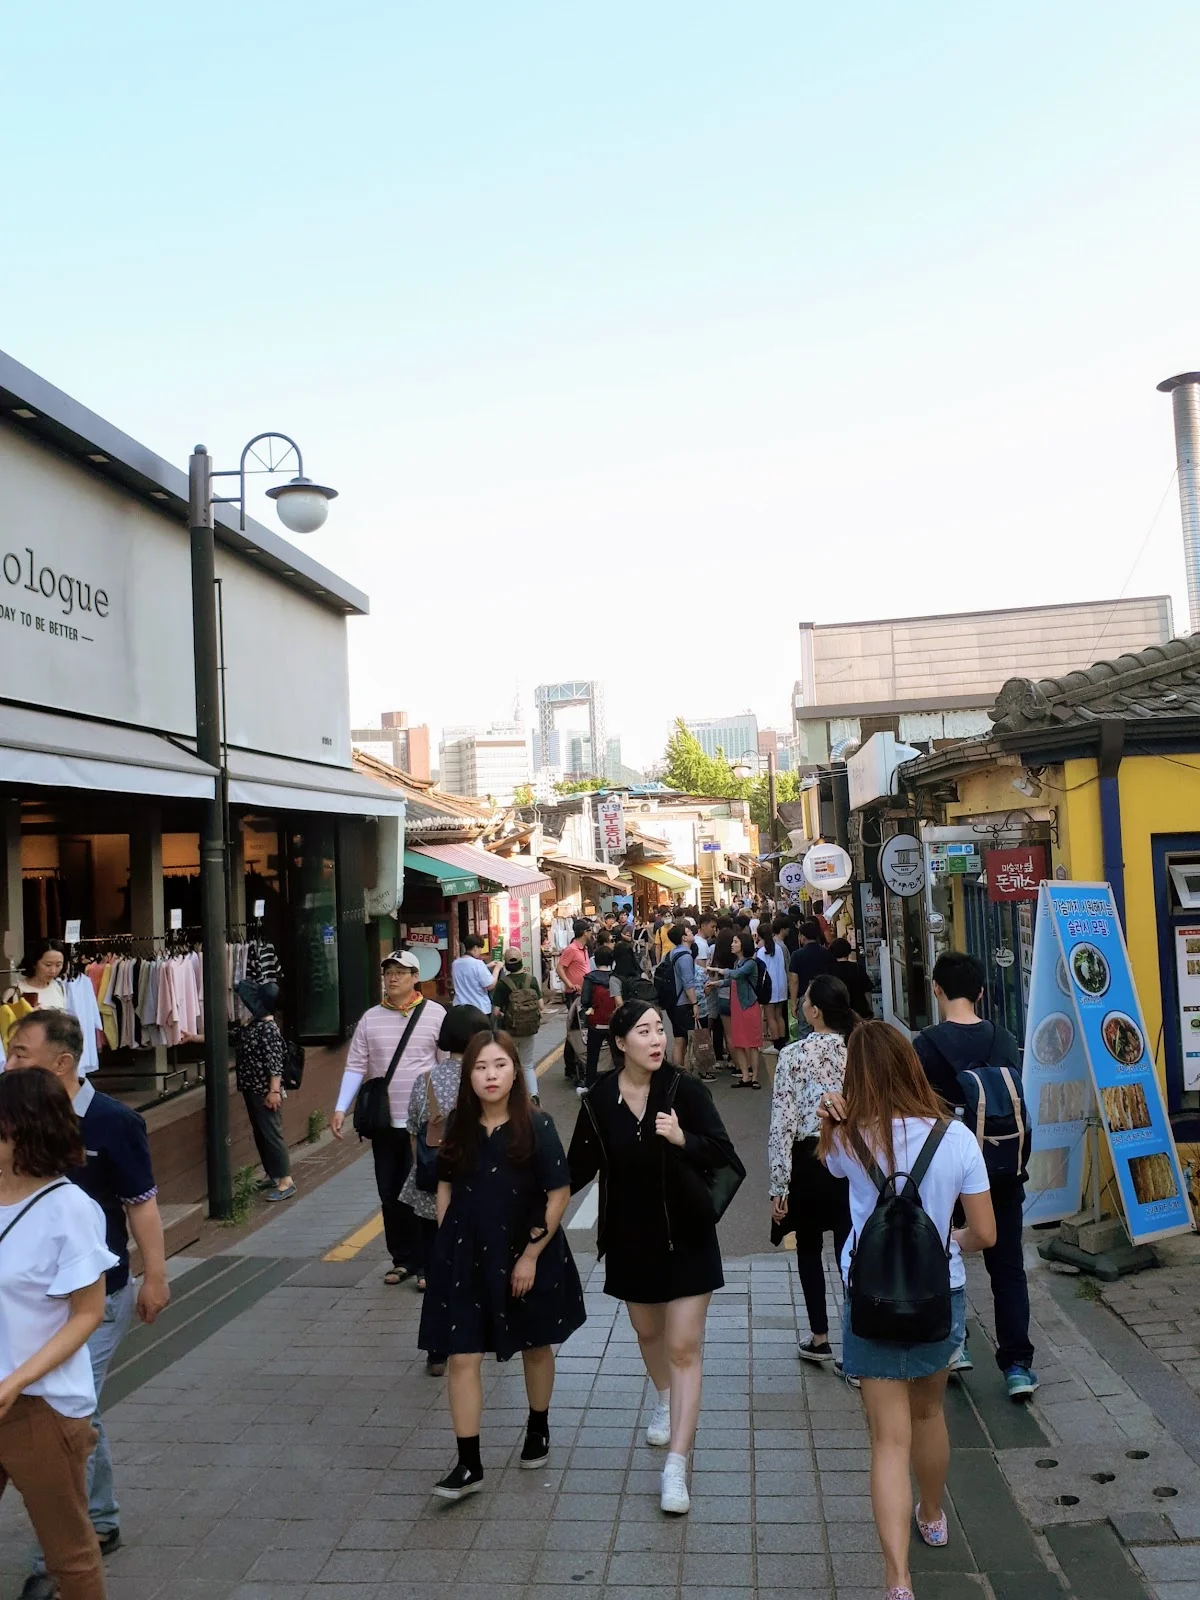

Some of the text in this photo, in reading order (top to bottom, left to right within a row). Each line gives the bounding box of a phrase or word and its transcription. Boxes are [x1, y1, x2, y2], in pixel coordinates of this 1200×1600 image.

[0, 547, 109, 618] ologue
[20, 611, 32, 627] TO
[35, 616, 45, 632] BE
[49, 621, 78, 641] BETTER
[603, 813, 621, 848] 부동산
[411, 933, 436, 943] OPEN
[1068, 920, 1090, 937] 슬러시
